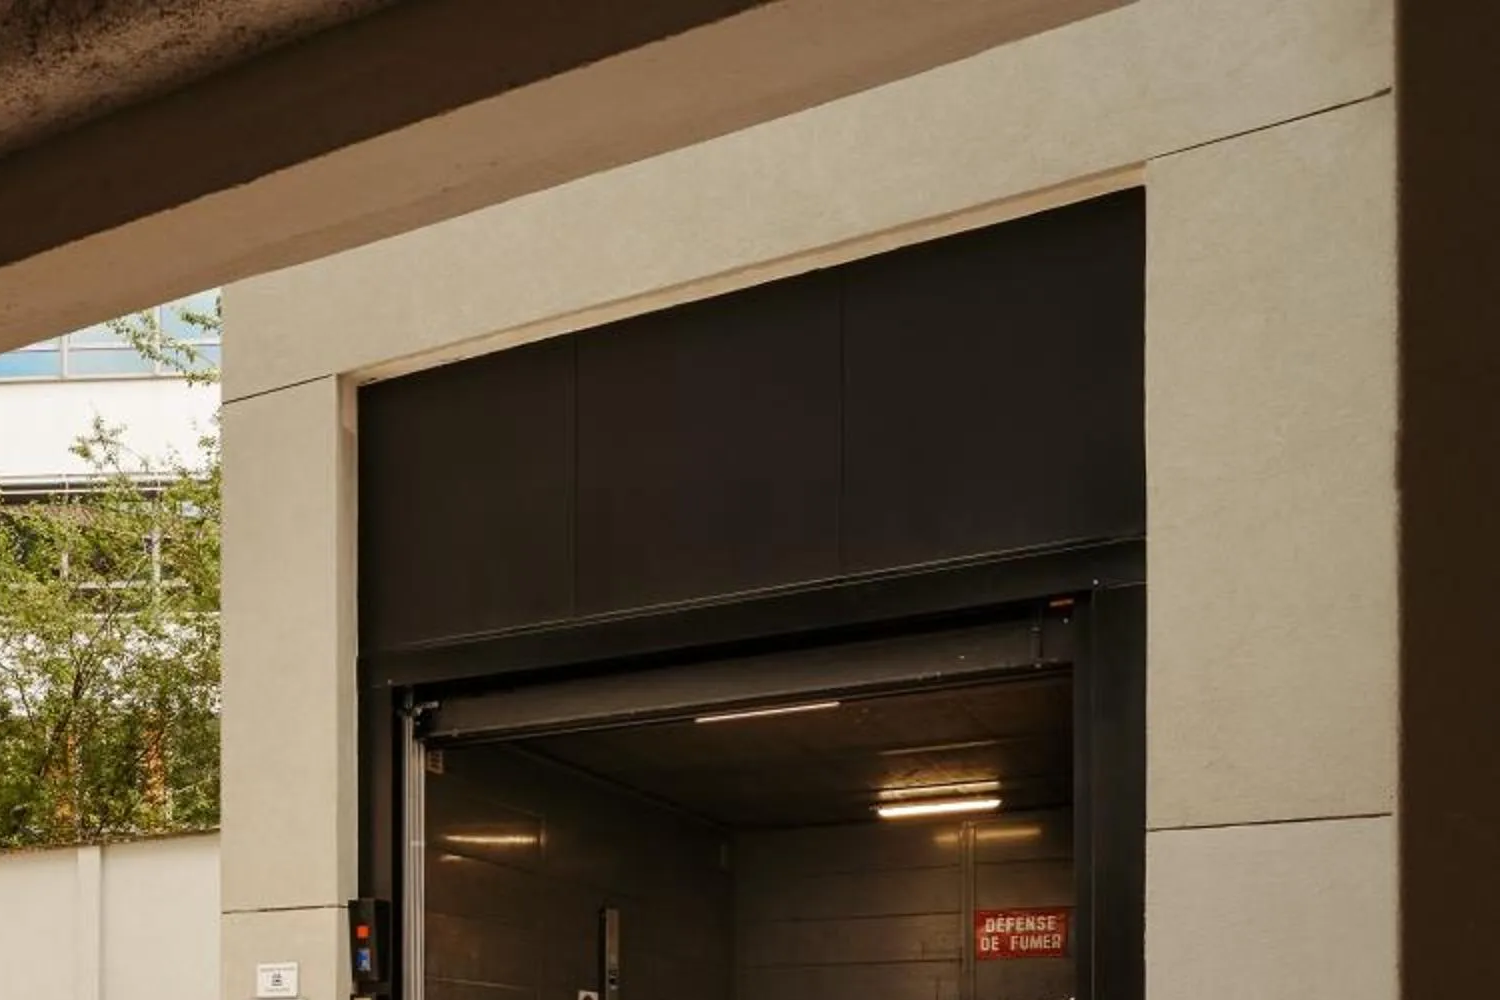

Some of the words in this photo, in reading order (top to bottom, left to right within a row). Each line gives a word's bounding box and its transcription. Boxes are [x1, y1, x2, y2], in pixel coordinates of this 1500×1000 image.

[985, 913, 1057, 934] DÉFENSE
[981, 935, 1000, 951] DE
[1010, 933, 1061, 951] FUMER
